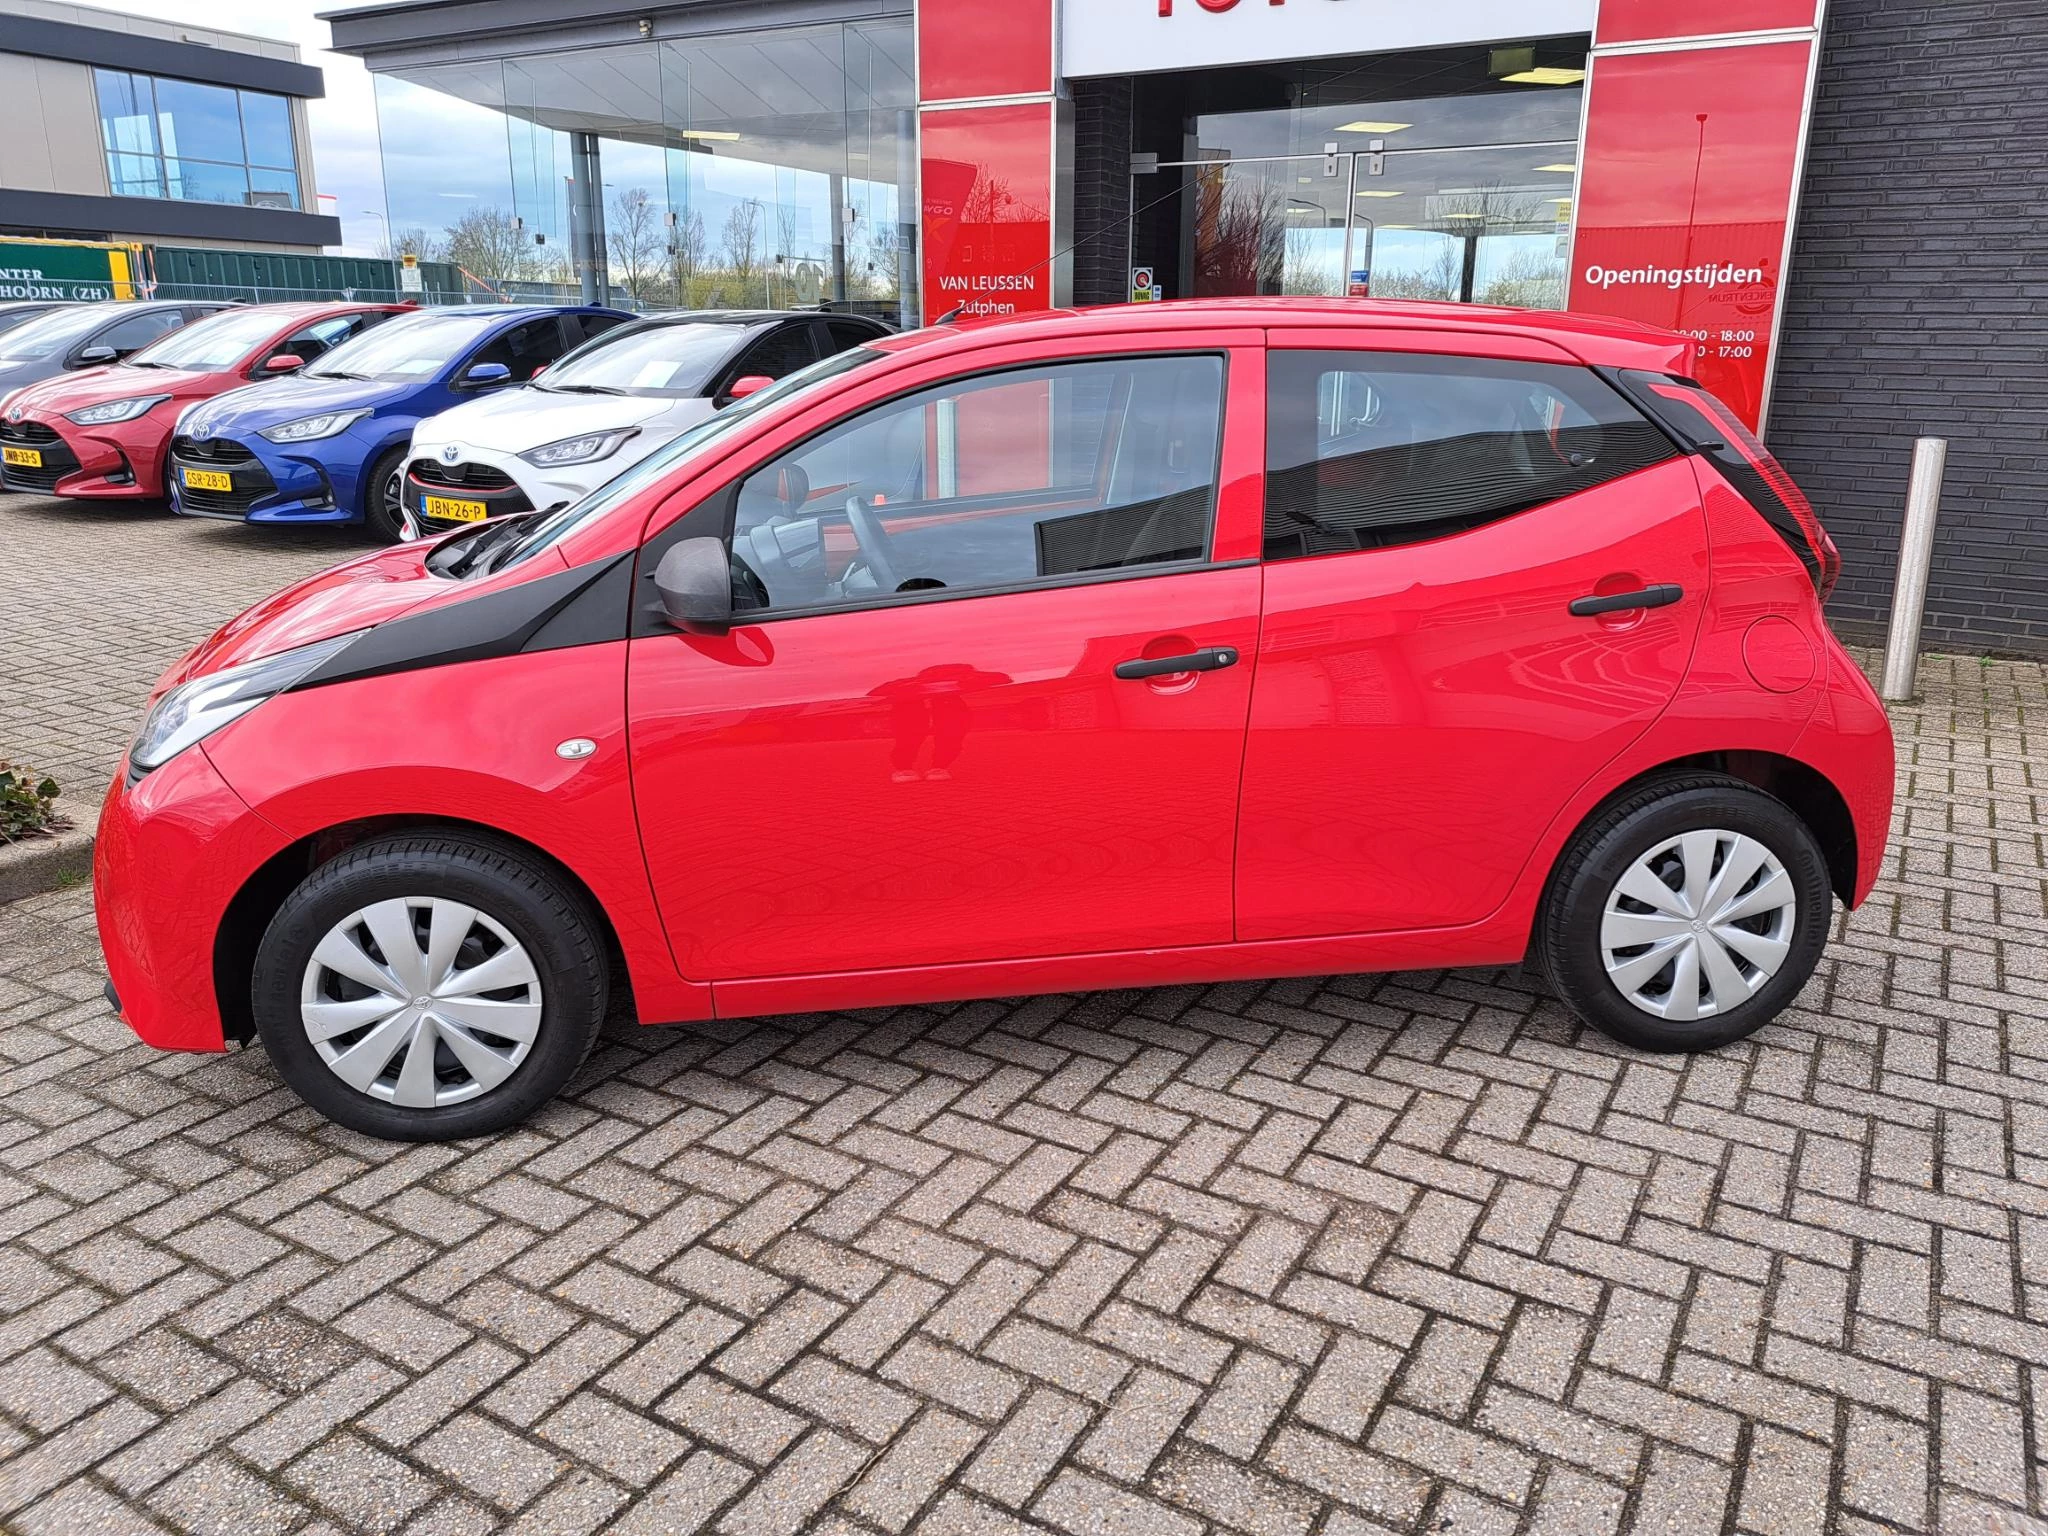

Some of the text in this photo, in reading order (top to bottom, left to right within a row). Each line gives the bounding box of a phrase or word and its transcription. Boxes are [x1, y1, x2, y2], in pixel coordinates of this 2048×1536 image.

[939, 275, 1034, 291] VAN LEUSSEN
[1585, 263, 1762, 290] Openingstijden
[72, 286, 110, 300] (ZH)
[957, 299, 1015, 317] Zutphen
[1720, 329, 1755, 342] 18:00
[1717, 346, 1753, 358] 17:00
[186, 471, 228, 488] GSR-28-D
[429, 500, 481, 519] JBN-26-P
